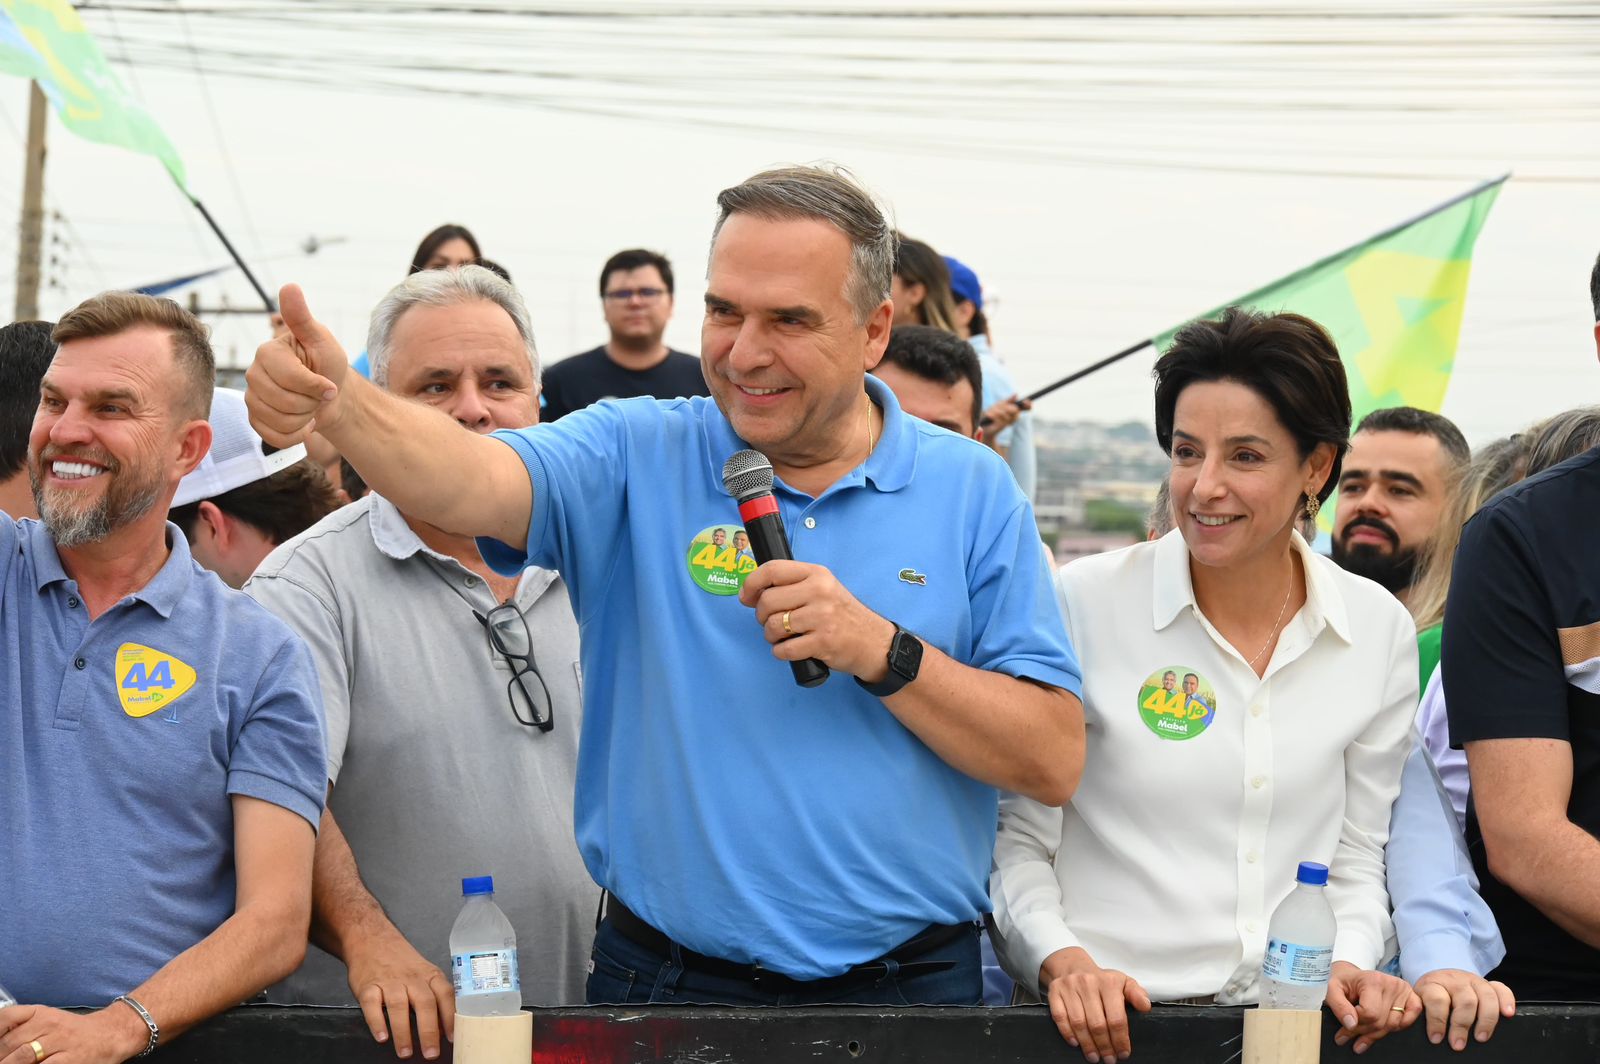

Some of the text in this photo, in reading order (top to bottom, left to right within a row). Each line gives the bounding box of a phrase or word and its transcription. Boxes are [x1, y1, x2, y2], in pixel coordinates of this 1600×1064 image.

[692, 544, 737, 572] 44
[707, 574, 739, 586] Mabel
[122, 661, 176, 691] 44
[1143, 688, 1187, 718] 44
[1157, 719, 1188, 732] Mabel
